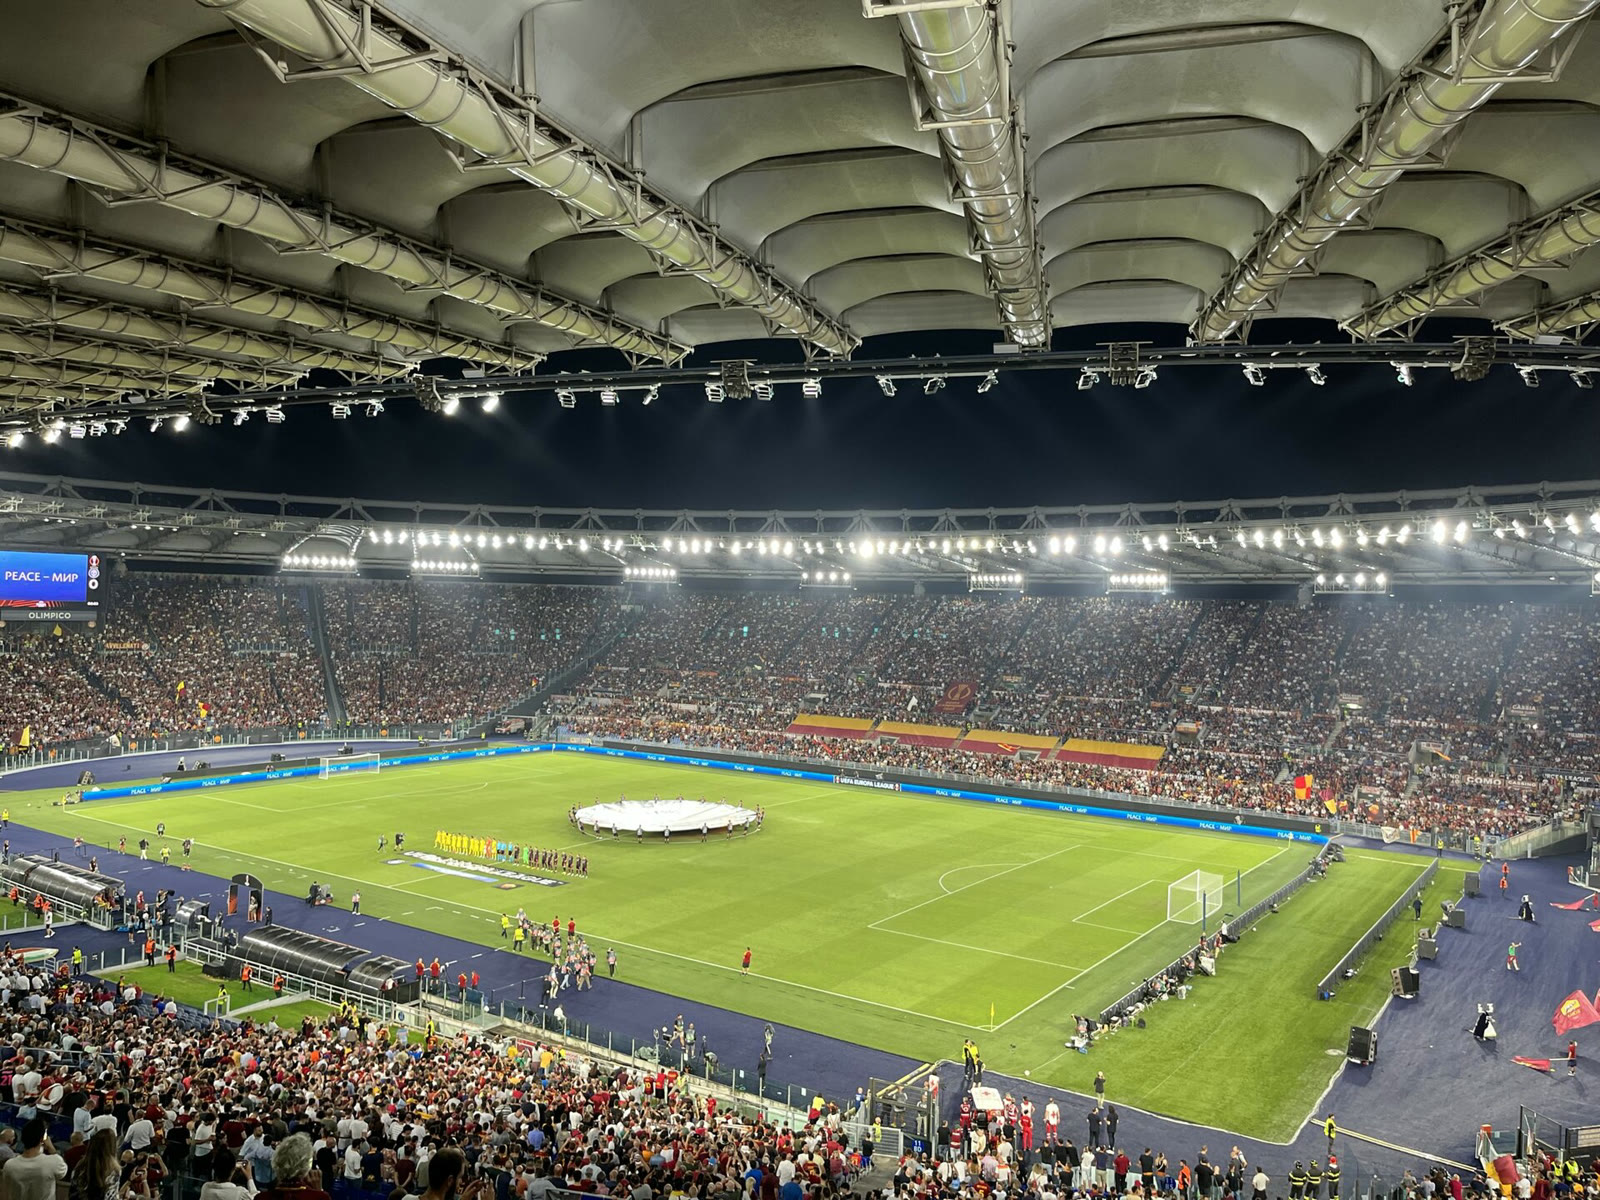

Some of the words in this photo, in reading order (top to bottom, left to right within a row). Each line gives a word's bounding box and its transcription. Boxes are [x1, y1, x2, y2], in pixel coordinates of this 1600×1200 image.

[5, 571, 41, 582] PEACE
[52, 573, 79, 582] МИР
[840, 777, 854, 785] UEFA
[854, 778, 874, 787] EUROPA
[874, 781, 895, 790] LEAGUE
[1466, 776, 1502, 785] COMO
